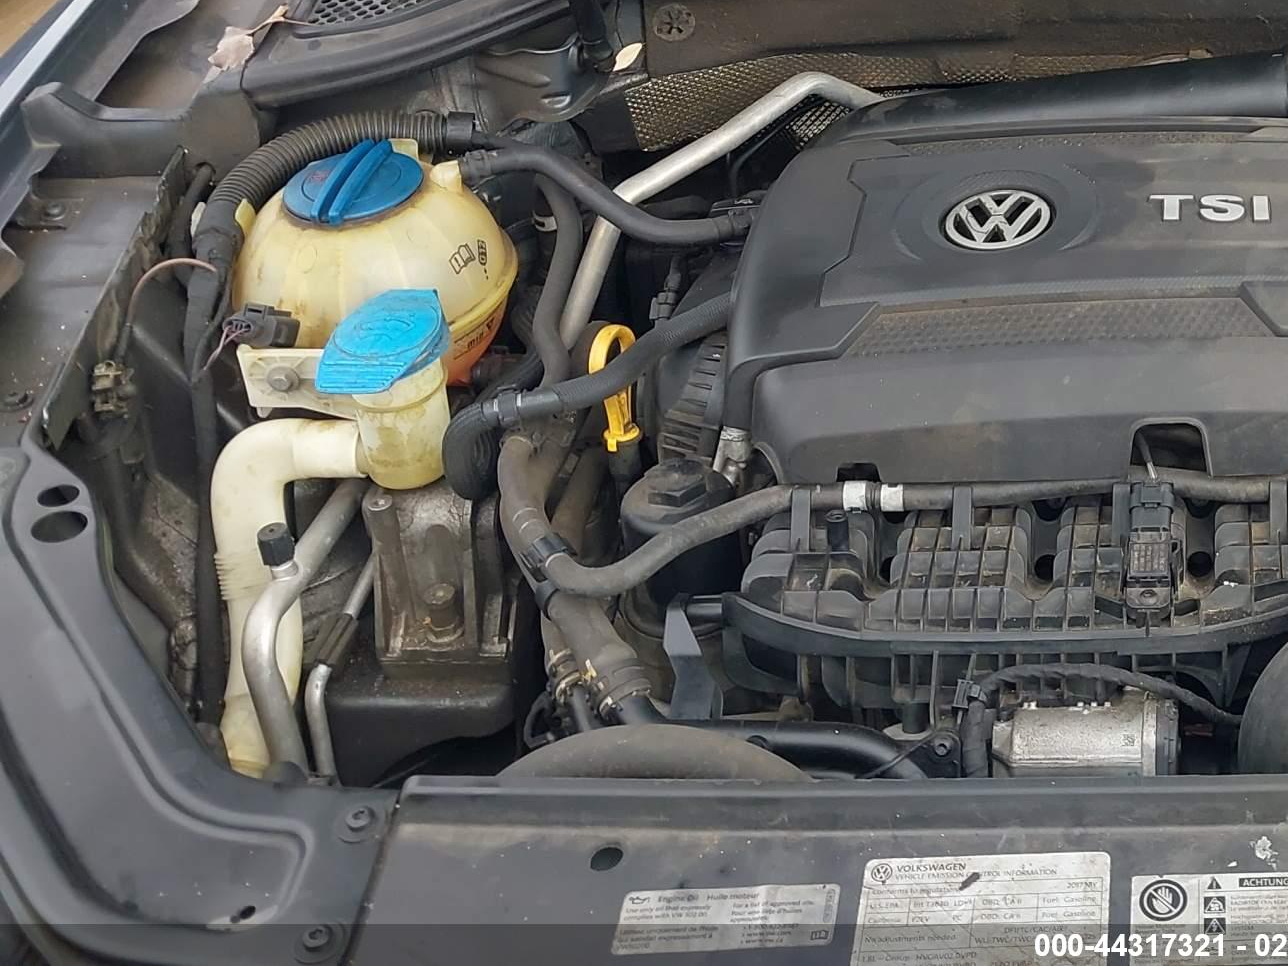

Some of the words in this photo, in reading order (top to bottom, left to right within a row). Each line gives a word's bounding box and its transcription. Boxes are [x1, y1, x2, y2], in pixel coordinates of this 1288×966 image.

[1149, 194, 1271, 222] TSI
[897, 863, 967, 872] VOLKSWAGEN
[1003, 868, 1057, 877] INFORMATION
